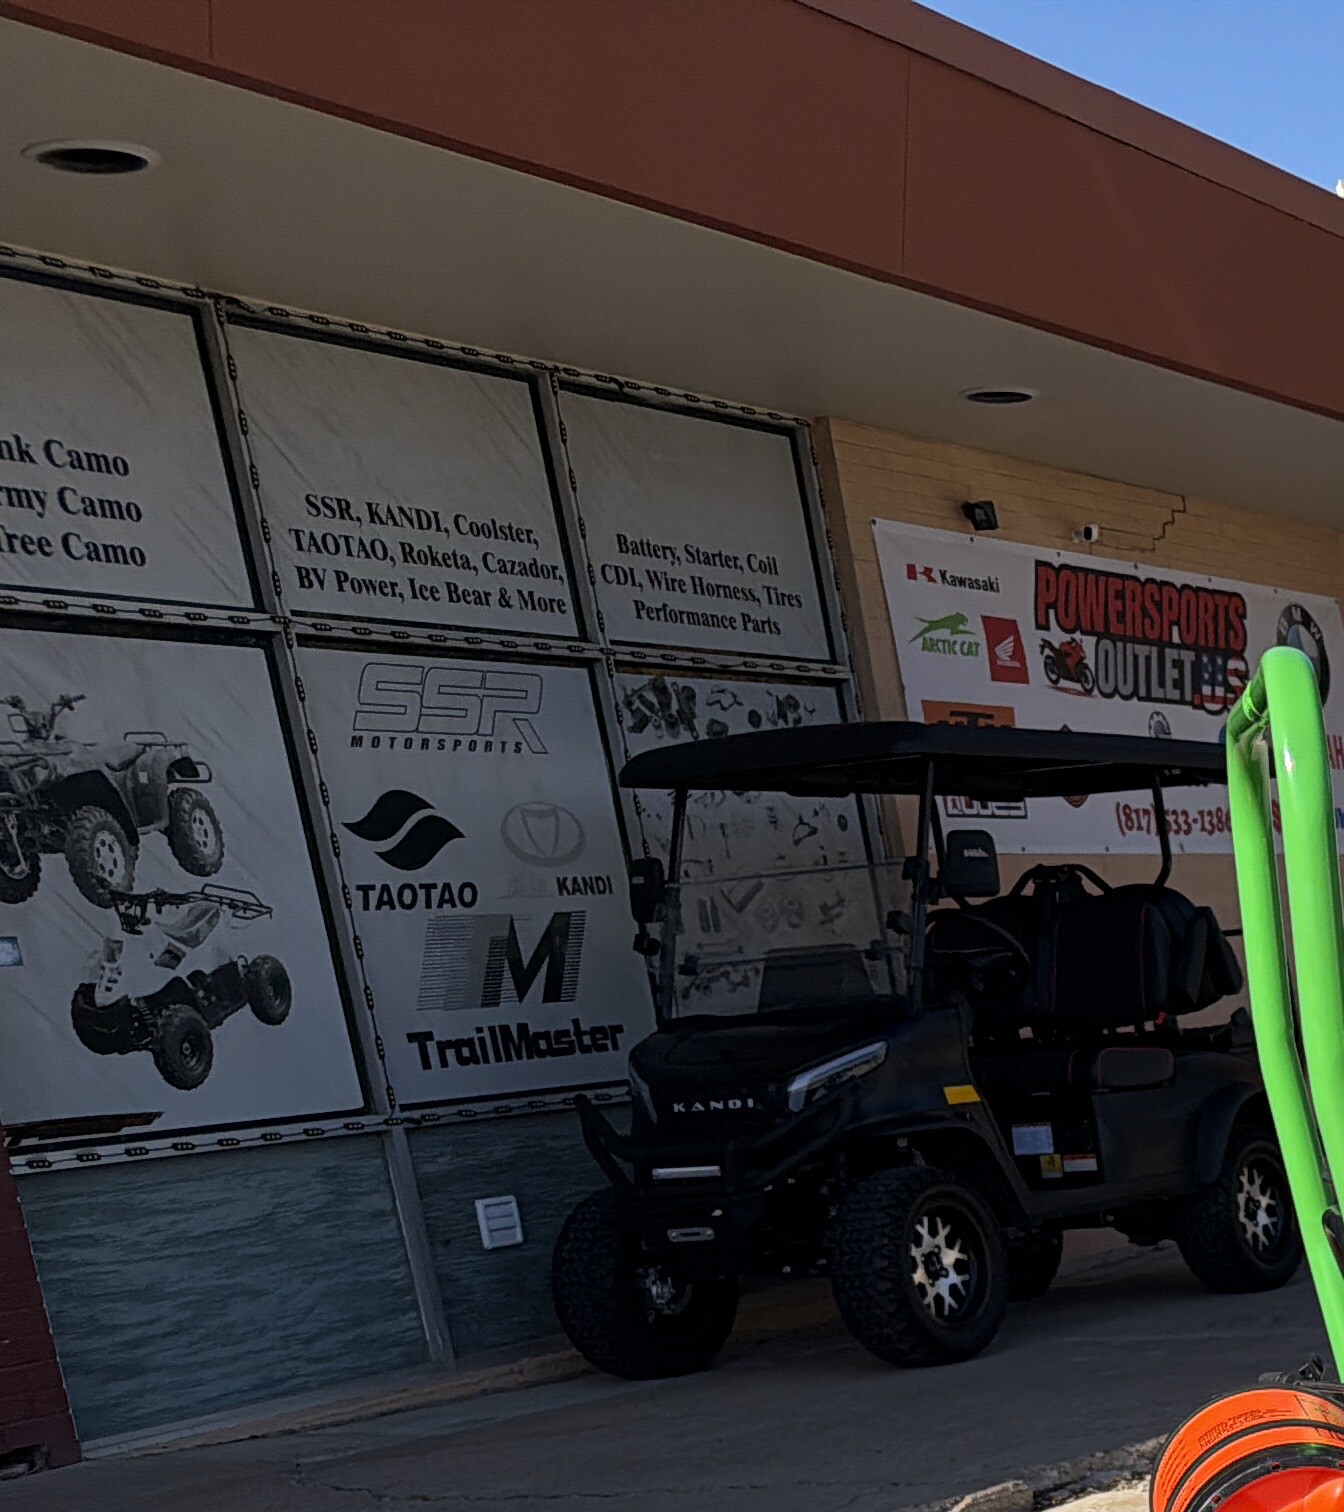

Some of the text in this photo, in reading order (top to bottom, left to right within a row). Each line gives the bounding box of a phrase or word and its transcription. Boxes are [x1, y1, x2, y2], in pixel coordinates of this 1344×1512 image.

[43, 438, 129, 477] Camo
[57, 486, 142, 523] Camo
[305, 493, 539, 550] SSR, KANDI, Coolster,
[61, 532, 146, 567] Camo
[289, 528, 564, 585] TAOTAO, Roketa, Cazador,
[615, 533, 779, 576] Battery, Starter, Coil
[294, 565, 567, 615] BV Power, Ice Bear & More
[601, 563, 644, 593] CDI,
[645, 569, 688, 593] Wire
[762, 585, 803, 609] Tires
[939, 568, 1001, 594] Kawasaki
[633, 599, 781, 636] Performance Parts
[1035, 559, 1248, 652] POWERSPORTS
[921, 636, 981, 658] ARCTIC CAT
[353, 661, 549, 755] SSR
[351, 735, 523, 754] MOTORSPORTS
[356, 881, 478, 912] TAOTAO
[556, 875, 614, 896] KANDI
[406, 1017, 625, 1070] TrailMaster
[672, 1097, 755, 1113] KANDI
